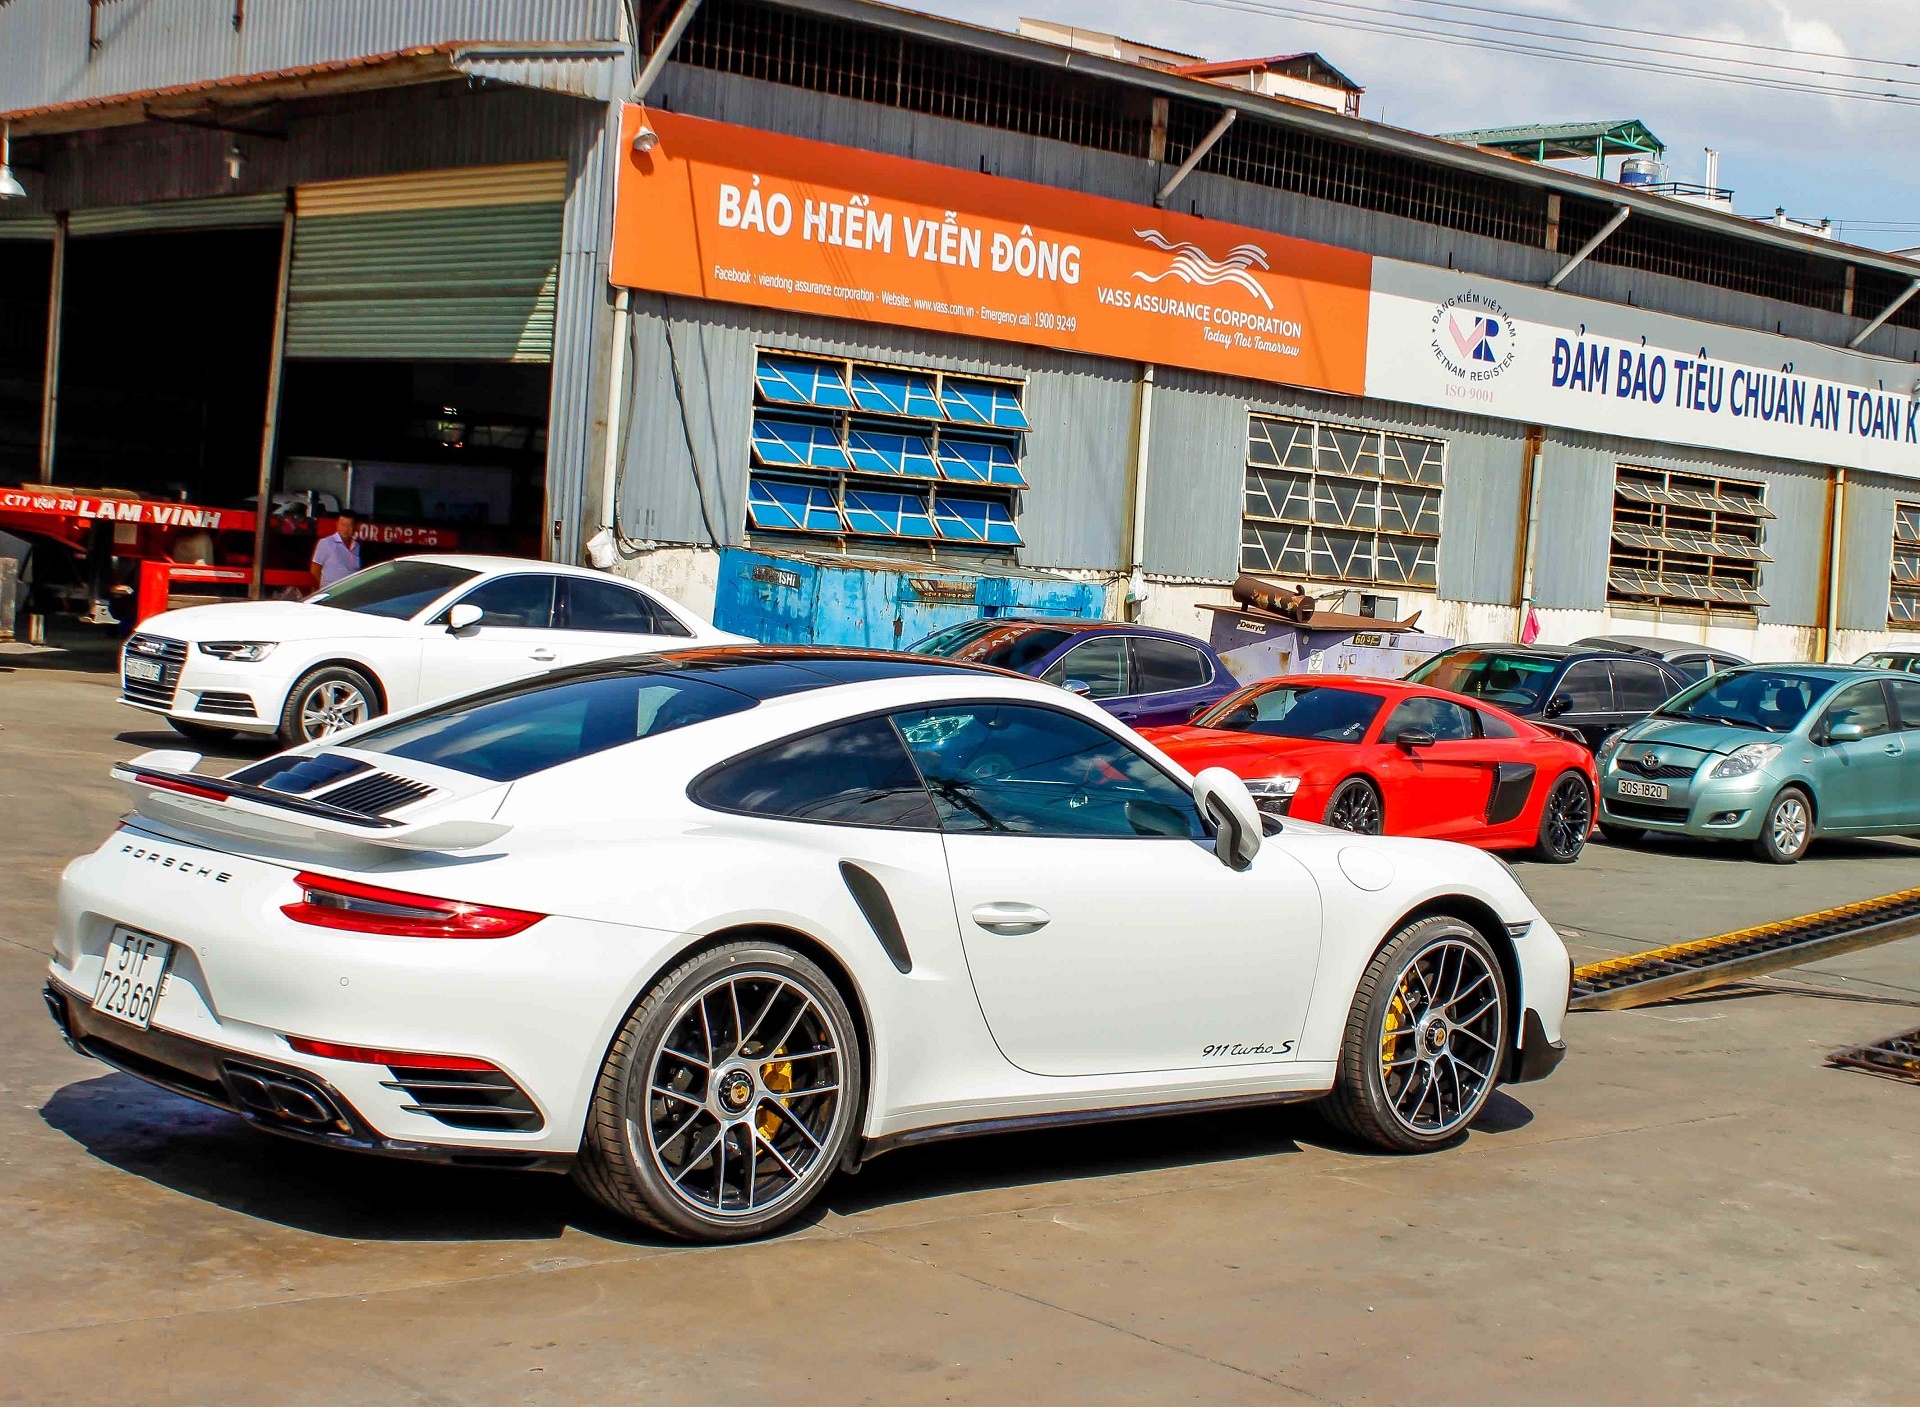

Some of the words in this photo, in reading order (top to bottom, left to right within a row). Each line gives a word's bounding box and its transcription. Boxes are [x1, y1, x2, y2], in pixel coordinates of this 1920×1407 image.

[718, 174, 792, 237] BẢO
[803, 195, 893, 254] HIỂM
[902, 210, 982, 269] VIỄN
[990, 224, 1081, 285] ĐÔNG
[714, 265, 752, 284] Facebook
[758, 272, 793, 293] viendong
[794, 279, 831, 296] assurance
[833, 285, 874, 302] corporation
[913, 298, 974, 318] www.vass.com.vn
[980, 306, 1017, 326] Emergency
[1034, 311, 1054, 329] 1900
[1056, 316, 1077, 333] 9249
[1097, 286, 1132, 308] VASS
[1133, 293, 1211, 322] ASSURANCE
[1213, 308, 1301, 339] CORPORATION
[1483, 296, 1502, 314] VIỆT
[1501, 312, 1516, 338] NAM
[1203, 326, 1232, 349] Today
[1234, 331, 1252, 348] Not
[1254, 336, 1300, 357] Tomorrow
[1431, 339, 1466, 379] VIETNAM
[1470, 352, 1515, 382] REGISTER
[1444, 383, 1467, 399] ISO
[1469, 387, 1494, 403] 9001
[1551, 323, 1610, 395] ĐẢM
[1616, 335, 1667, 404] BẢO
[1730, 361, 1806, 426] CHUẨN
[1810, 384, 1841, 431] AN
[1847, 379, 1901, 441] TOÀN
[1620, 782, 1662, 798] 30S-1820
[120, 845, 233, 883] PORSCHE
[118, 935, 155, 977] 51F
[1202, 1044, 1230, 1057] 911
[1272, 1040, 1295, 1055] S
